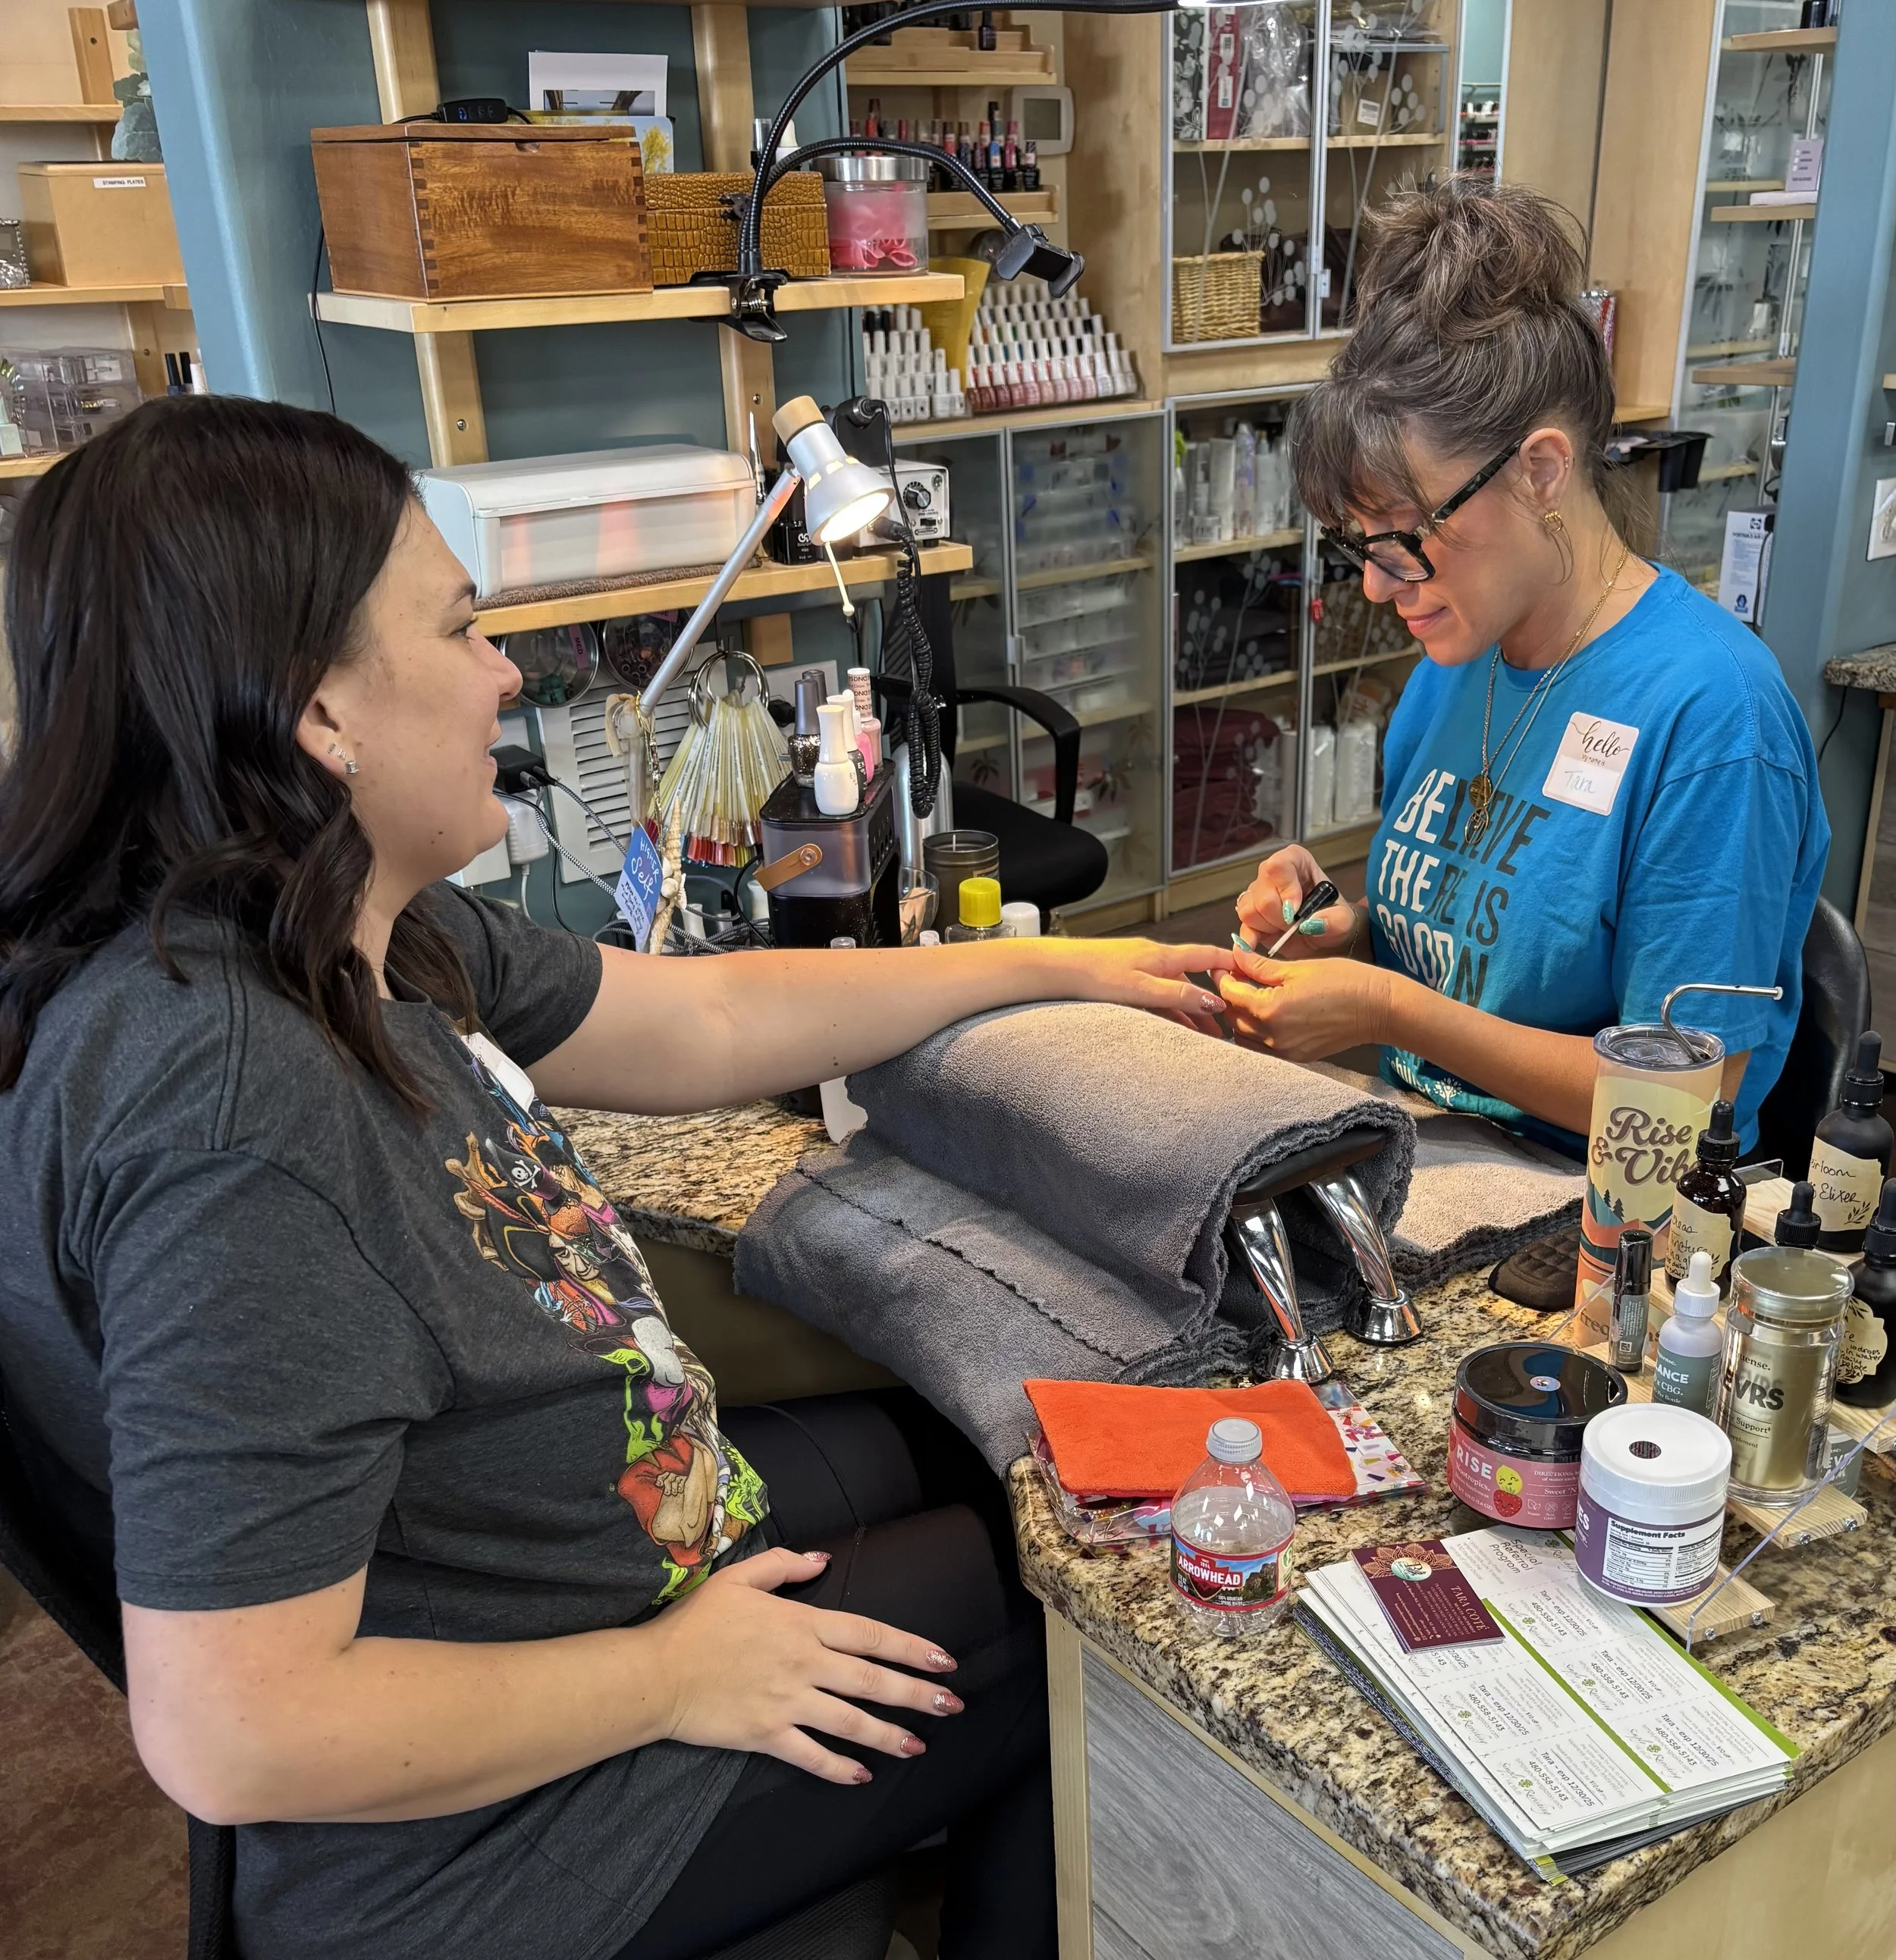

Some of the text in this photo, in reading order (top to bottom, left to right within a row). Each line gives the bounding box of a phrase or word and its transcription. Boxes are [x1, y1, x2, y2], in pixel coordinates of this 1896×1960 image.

[575, 637, 583, 655] MED
[1570, 720, 1630, 757] hello
[1565, 770, 1596, 794] Tara
[640, 836, 660, 884] HIGHER
[631, 857, 654, 901] Self
[1378, 839, 1509, 947] THERE IS
[1376, 903, 1455, 996] GOOD
[1606, 1106, 1694, 1146] Rise
[1591, 1136, 1614, 1166] &
[1811, 1159, 1857, 1178] irloom
[1656, 1364, 1689, 1385] ANCE
[1855, 1353, 1882, 1361] water
[1661, 1381, 1684, 1396] CBG.
[1732, 1378, 1785, 1411] VRS
[1456, 1444, 1493, 1481] RISE
[1611, 1519, 1686, 1539] Supplement Facts
[1178, 1555, 1241, 1585] ARROWHEAD
[1487, 1544, 1521, 1573] Program
[1500, 1541, 1533, 1570] Referral
[1509, 1539, 1543, 1566] Special
[1450, 1585, 1471, 1606] TARA
[1464, 1606, 1489, 1632] COTÉ
[1530, 1601, 1567, 1636] 480-558-5143
[1540, 1590, 1587, 1636] Tara exp 12/30/25
[1446, 1649, 1468, 1667] 2/30/25
[1600, 1650, 1653, 1700] Tara exp 12/30/25
[1590, 1662, 1629, 1699] 480-558-5143
[1467, 1693, 1505, 1730] 480-558-5143
[1477, 1684, 1529, 1735] Tara exp 12/30/25
[1654, 1726, 1697, 1766] 480-558-5143
[1660, 1714, 1719, 1767] Tara exp 12/30/25
[1527, 1761, 1568, 1801] 480-558-5143
[1540, 1751, 1555, 1764] Tara
[1555, 1770, 1570, 1781] exp
[1566, 1780, 1594, 1806] 12/30/25
